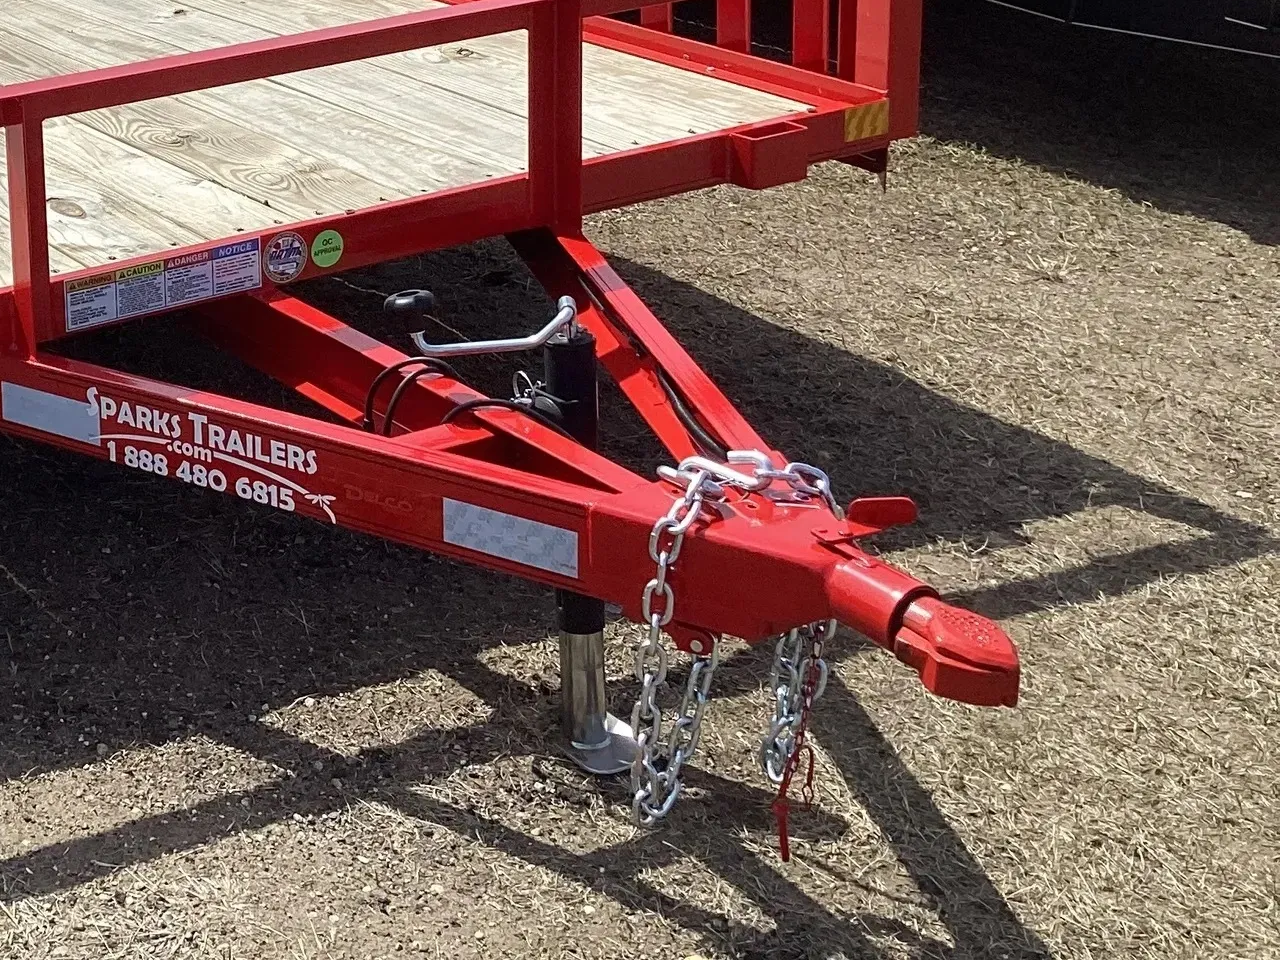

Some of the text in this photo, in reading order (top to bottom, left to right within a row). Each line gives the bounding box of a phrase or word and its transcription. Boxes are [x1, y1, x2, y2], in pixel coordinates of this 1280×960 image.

[321, 238, 333, 246] QC
[219, 243, 252, 257] NOTICE
[313, 245, 341, 257] APPROVAL
[175, 252, 209, 266] DANGER
[126, 263, 161, 277] CAUTION
[77, 275, 112, 288] WARNING
[86, 386, 318, 475] SPARKS TRAILERS
[167, 440, 213, 463] .com
[107, 440, 296, 512] 1 888 480 6815
